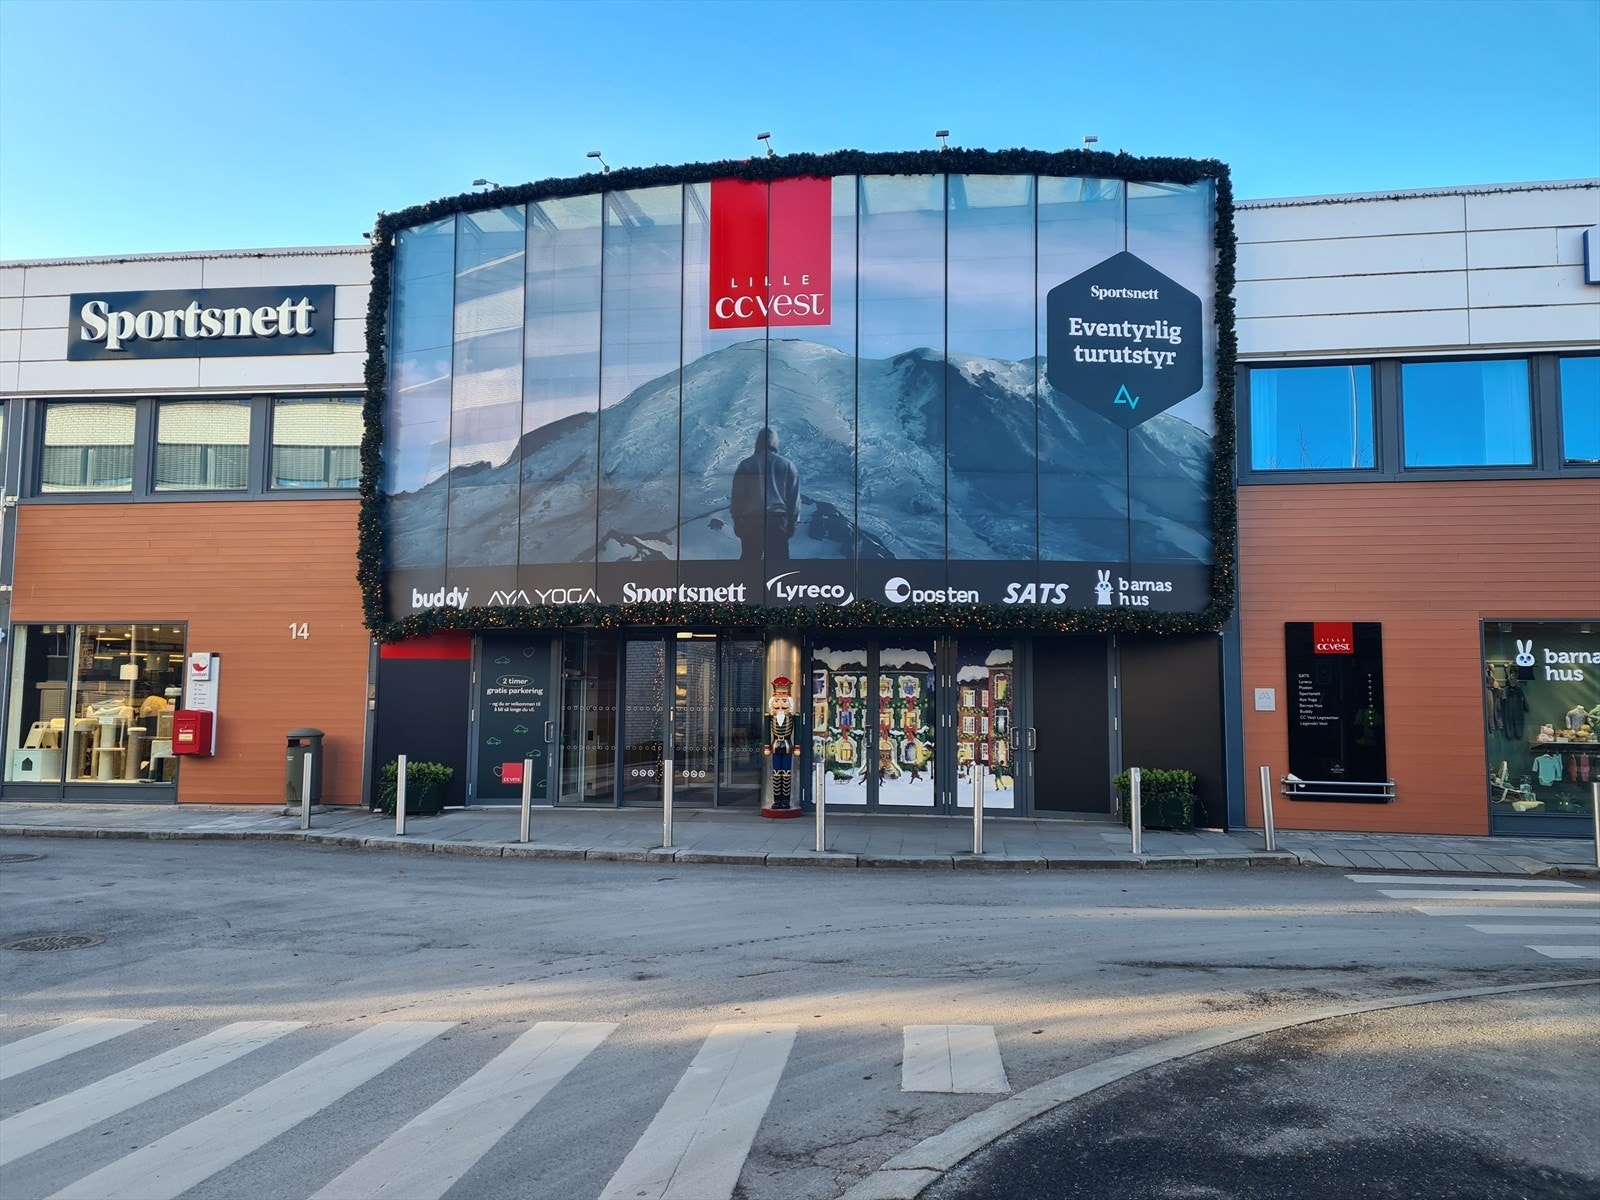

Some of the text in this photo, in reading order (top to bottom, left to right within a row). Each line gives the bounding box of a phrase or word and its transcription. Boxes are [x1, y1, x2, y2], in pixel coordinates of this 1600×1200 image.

[731, 275, 810, 288] LILLE
[1090, 285, 1159, 300] Sportsnett
[81, 296, 316, 351] Sportsnett
[1068, 317, 1182, 345] Eventyrlig
[1073, 345, 1177, 369] turutstyr
[622, 582, 747, 604] Sportsnett
[776, 581, 845, 602] Lyreco
[1002, 582, 1070, 604] SATS
[1118, 577, 1173, 592] barnas
[411, 587, 470, 610] buddy
[487, 588, 602, 605] AYA YOGA
[912, 587, 979, 603] posten
[1118, 592, 1150, 606] hus
[288, 622, 310, 640] 14
[508, 677, 529, 685] timer
[1545, 665, 1584, 681] hus
[487, 687, 544, 695] gratis parkering
